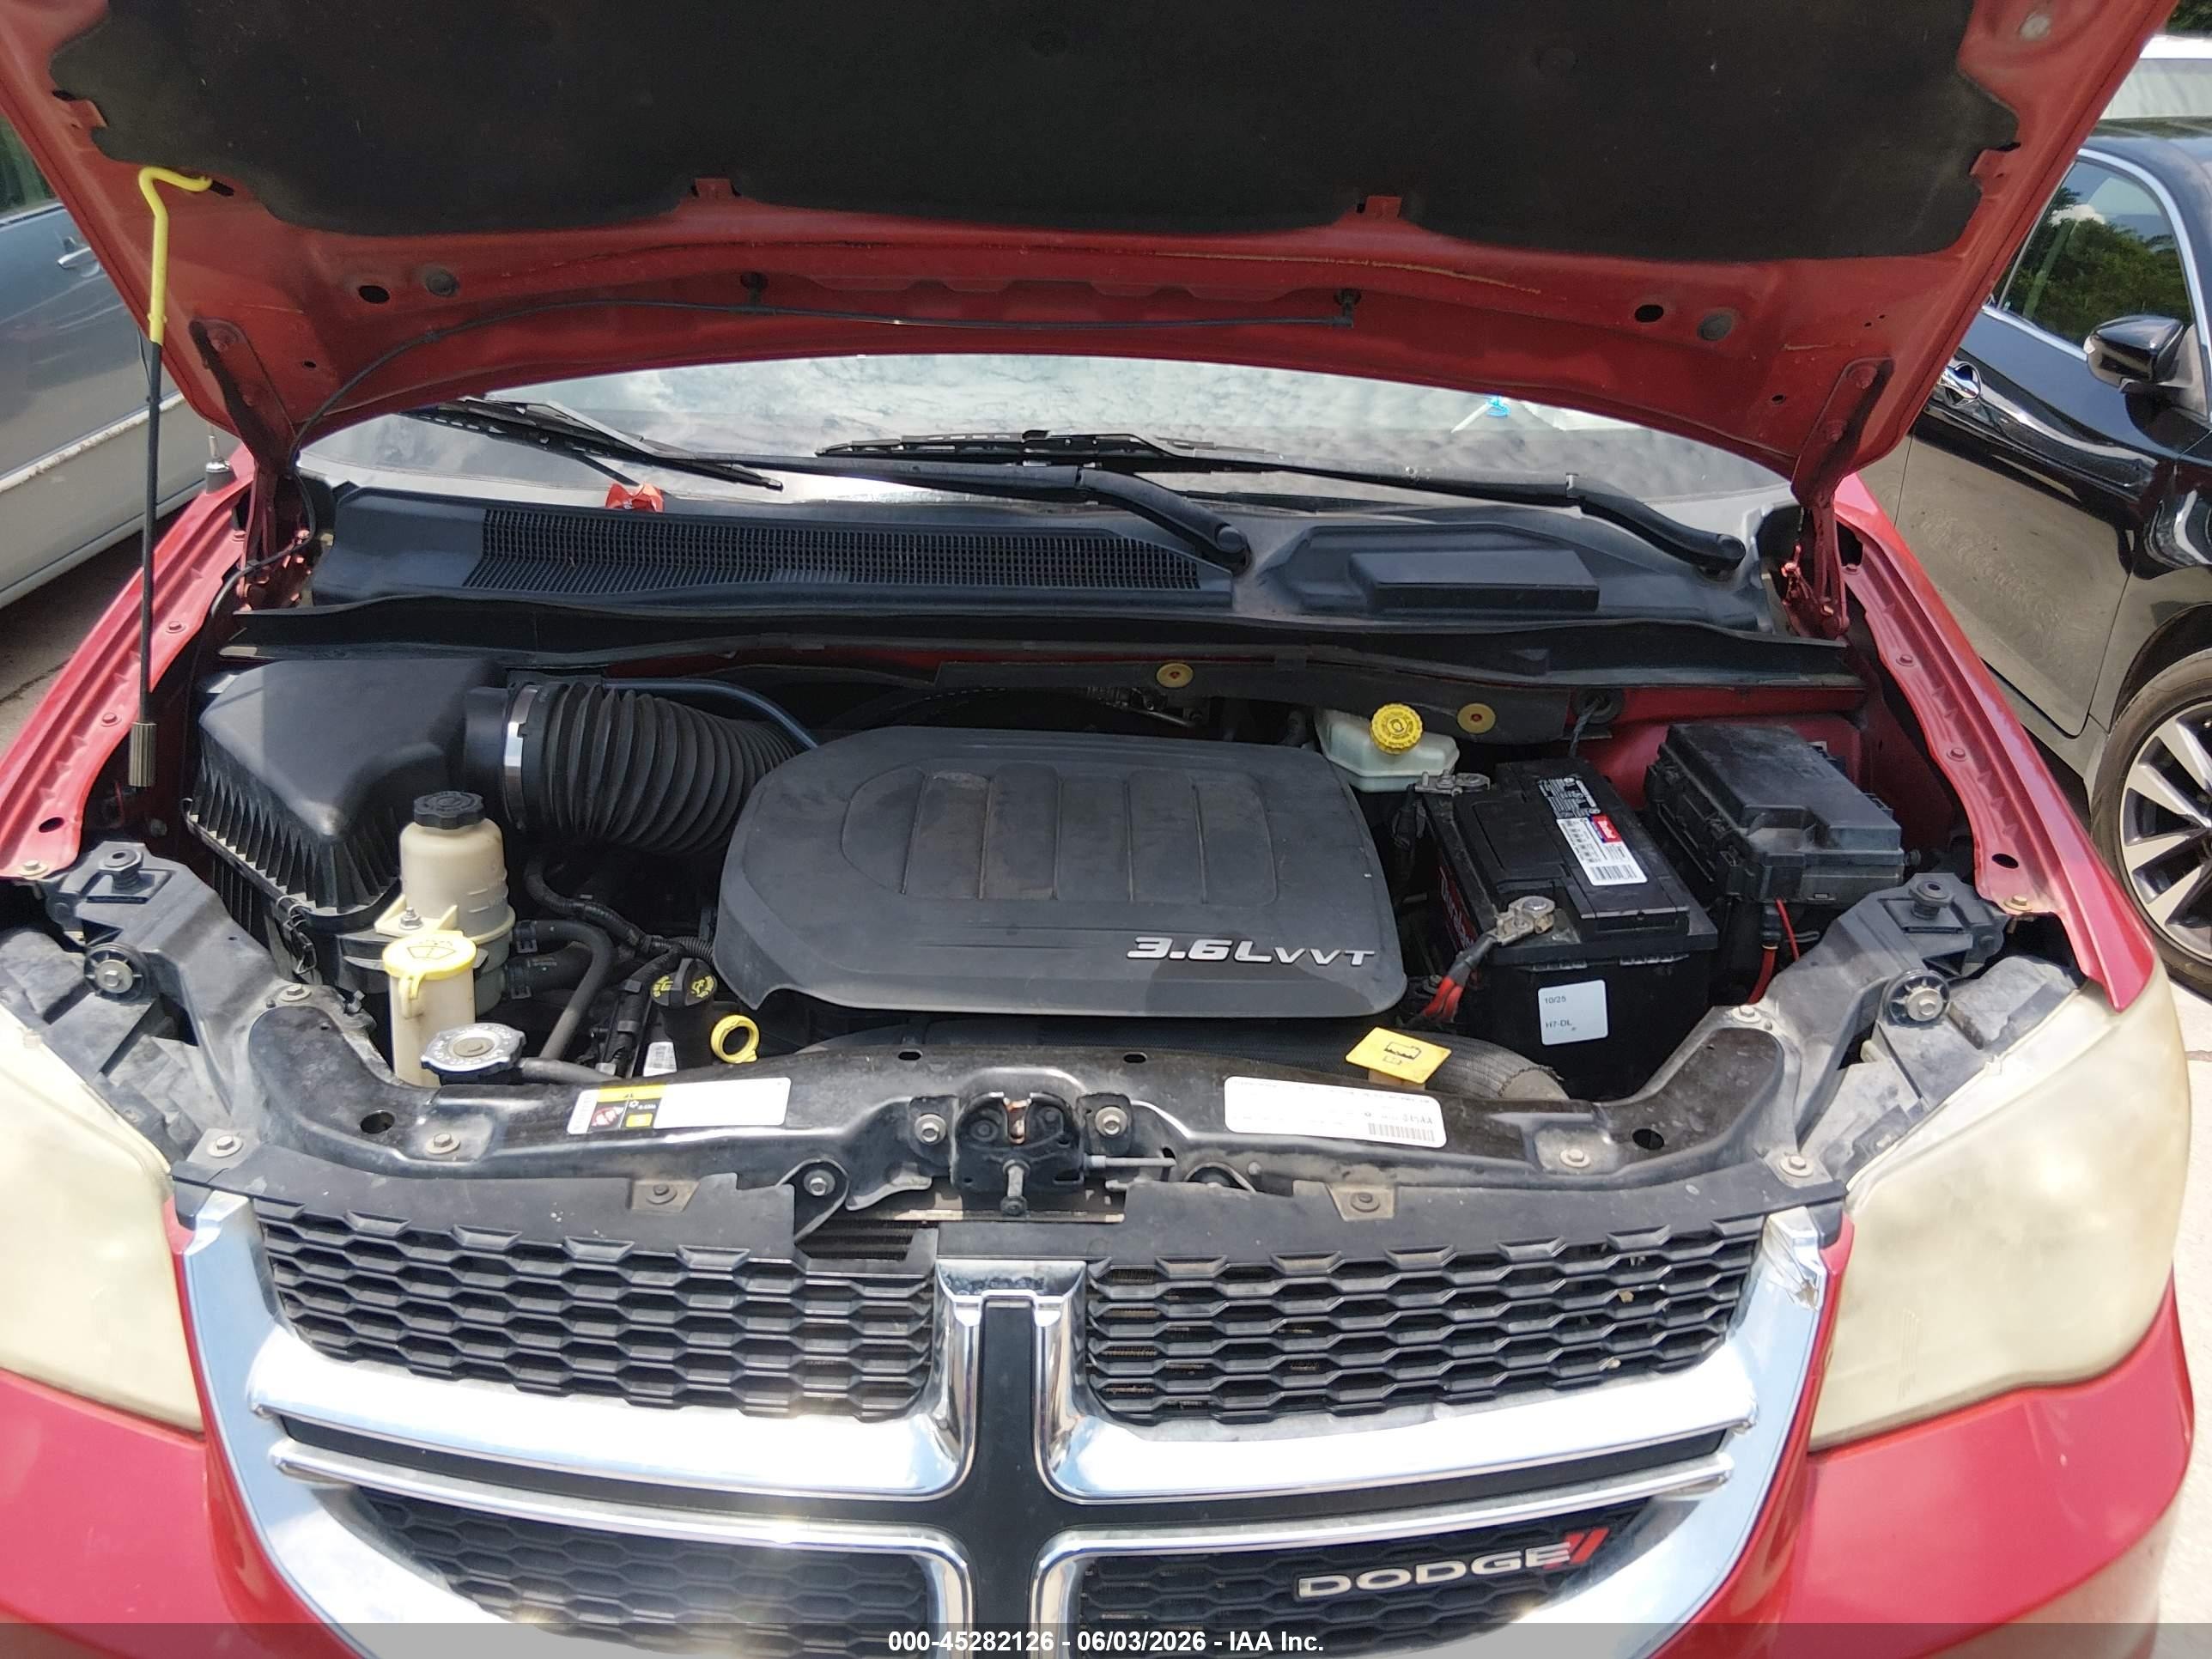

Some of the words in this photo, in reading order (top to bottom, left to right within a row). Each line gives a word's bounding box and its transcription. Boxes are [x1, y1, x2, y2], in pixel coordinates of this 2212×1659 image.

[1126, 935, 1273, 963] 3.6L
[1274, 945, 1376, 966] VVT
[1298, 1541, 1571, 1599] DODGE
